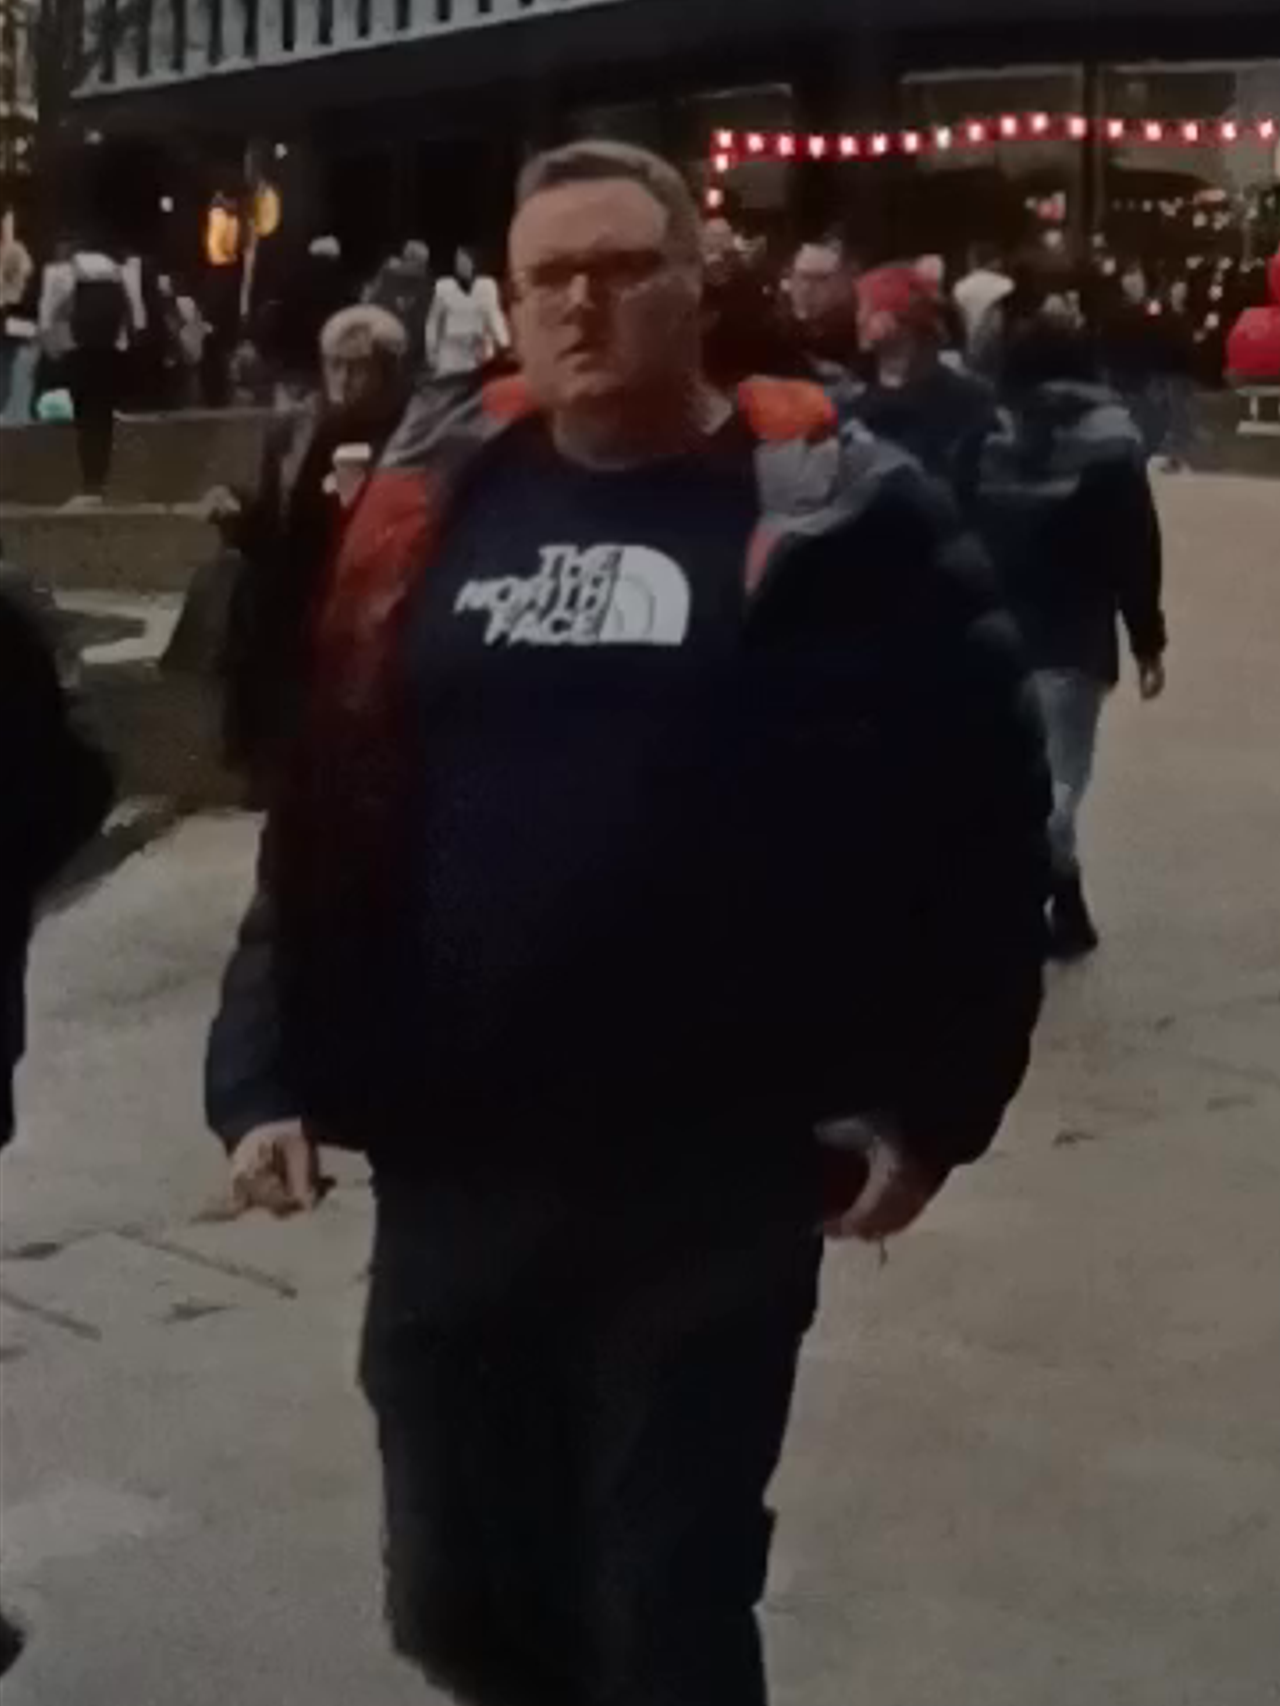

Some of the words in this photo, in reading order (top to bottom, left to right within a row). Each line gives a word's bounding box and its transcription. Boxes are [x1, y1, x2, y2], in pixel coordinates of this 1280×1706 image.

[539, 543, 621, 577] THE
[453, 575, 613, 613] NORTH
[483, 611, 603, 647] FACE
